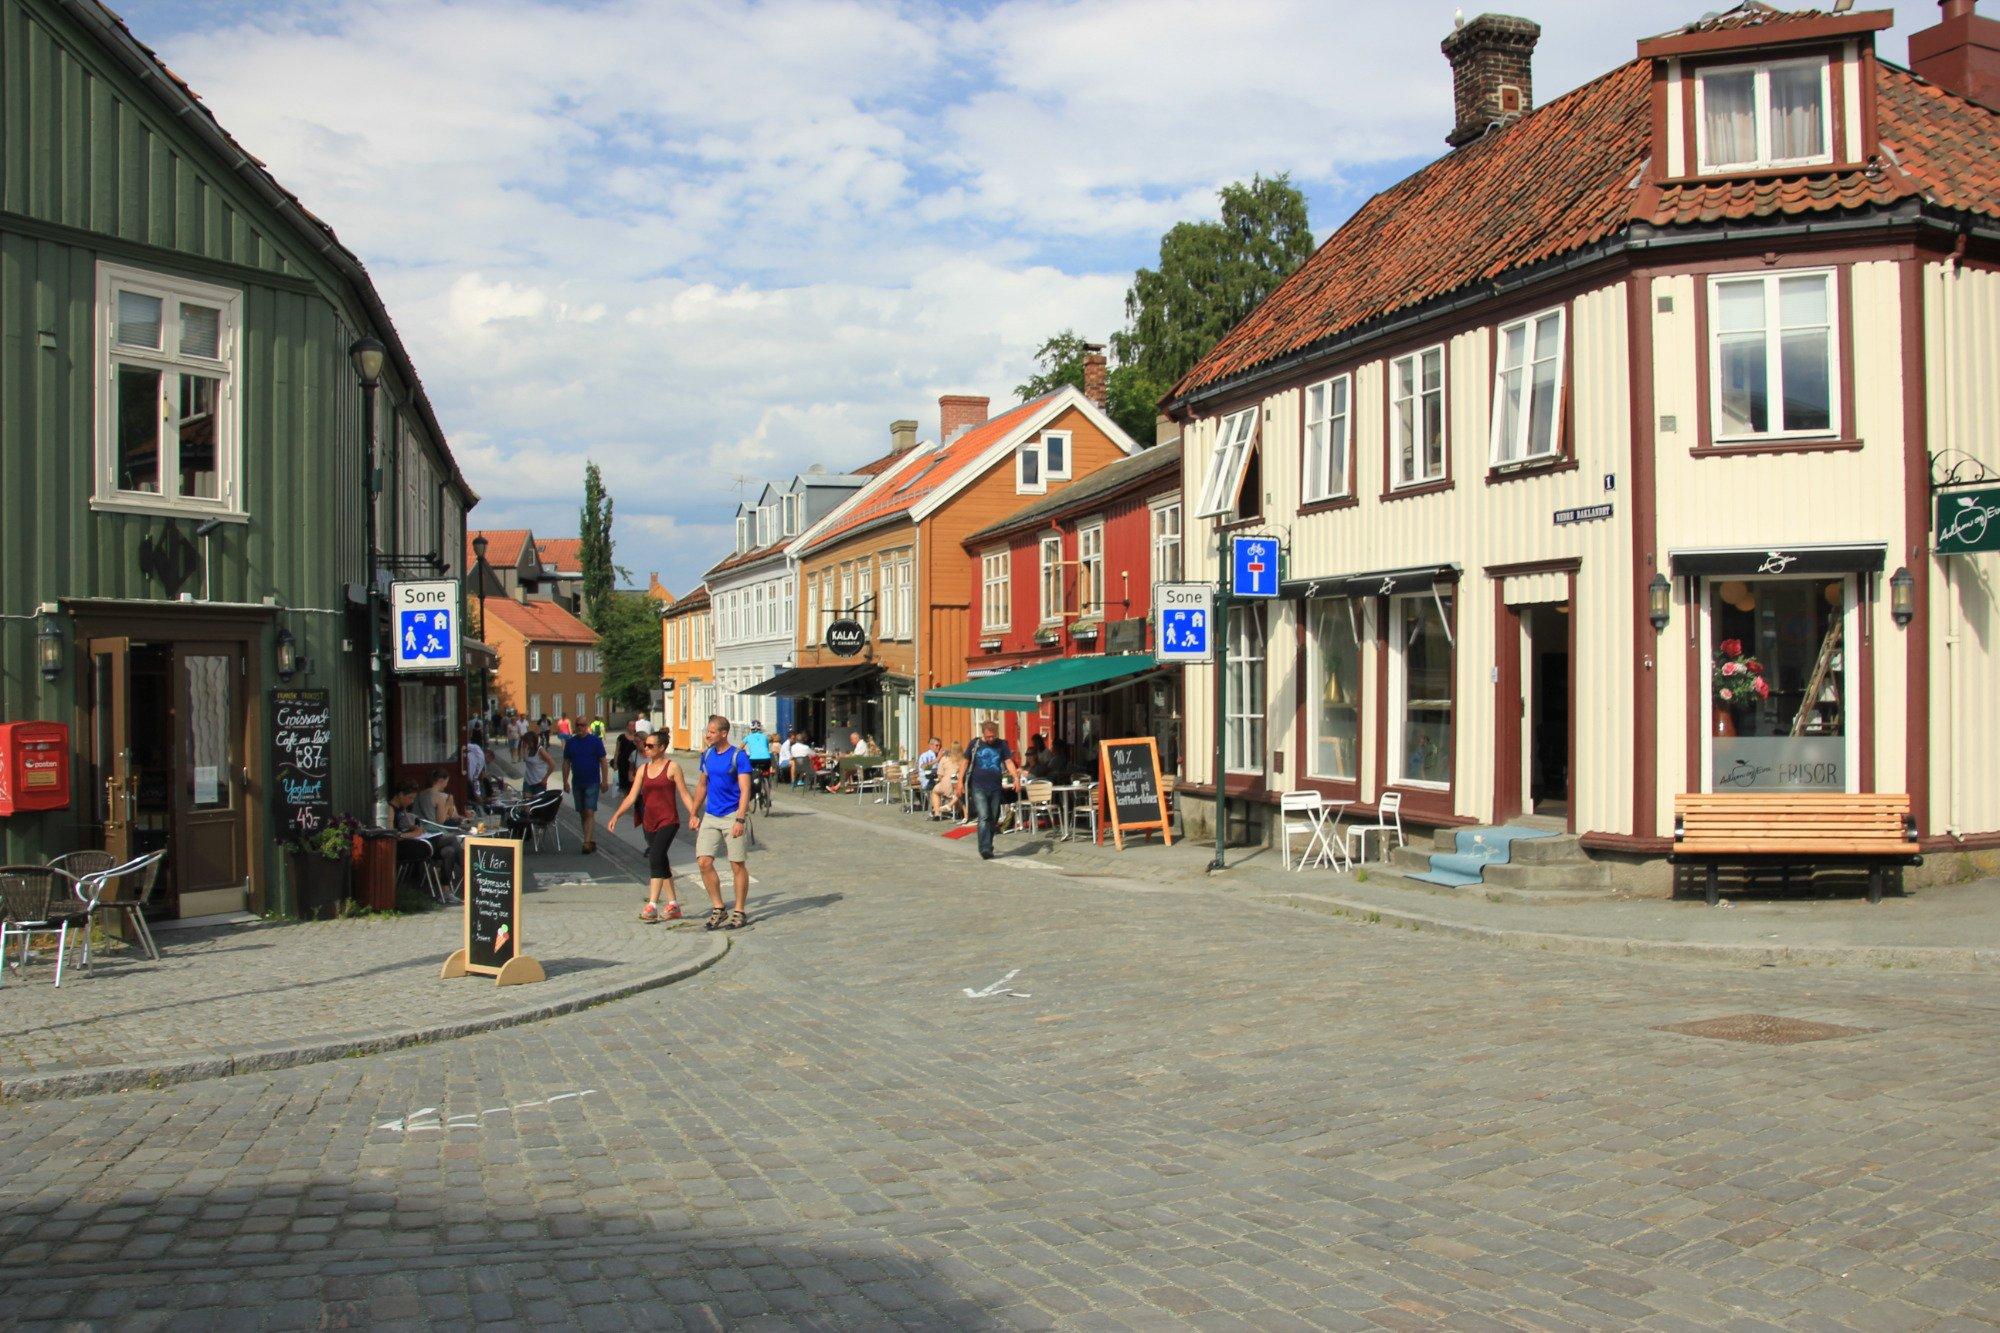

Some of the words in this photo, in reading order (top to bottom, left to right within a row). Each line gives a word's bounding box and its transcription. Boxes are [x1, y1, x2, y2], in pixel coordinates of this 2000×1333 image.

[1606, 475, 1612, 489] 1
[1986, 506, 2000, 518] Ev
[404, 588, 446, 604] Sone
[1166, 590, 1202, 603] Sone
[278, 707, 330, 726] Croissant
[276, 730, 300, 753] Café
[299, 736, 311, 744] au
[311, 729, 331, 744] lait
[1779, 763, 1837, 785] FRISØR
[283, 778, 321, 804] Yoghurt
[1115, 781, 1137, 793] rabatt
[477, 850, 486, 869] Vi
